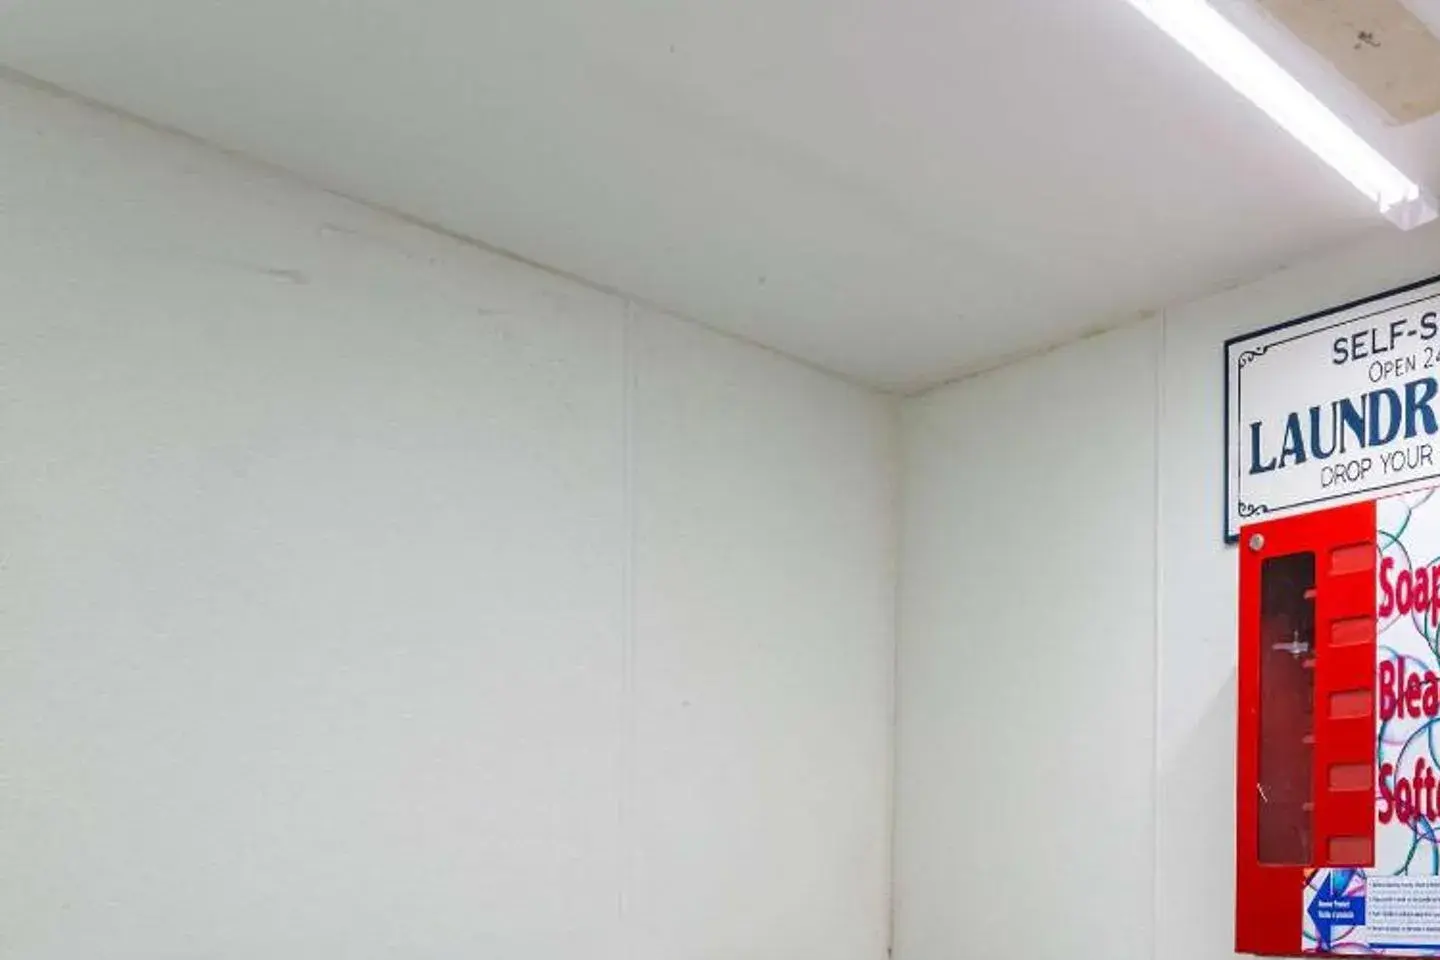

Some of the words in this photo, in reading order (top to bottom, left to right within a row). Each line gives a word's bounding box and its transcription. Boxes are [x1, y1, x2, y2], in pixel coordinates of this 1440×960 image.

[1368, 354, 1417, 383] OPEN
[1320, 456, 1372, 488] DROP
[1382, 447, 1433, 475] YOUR
